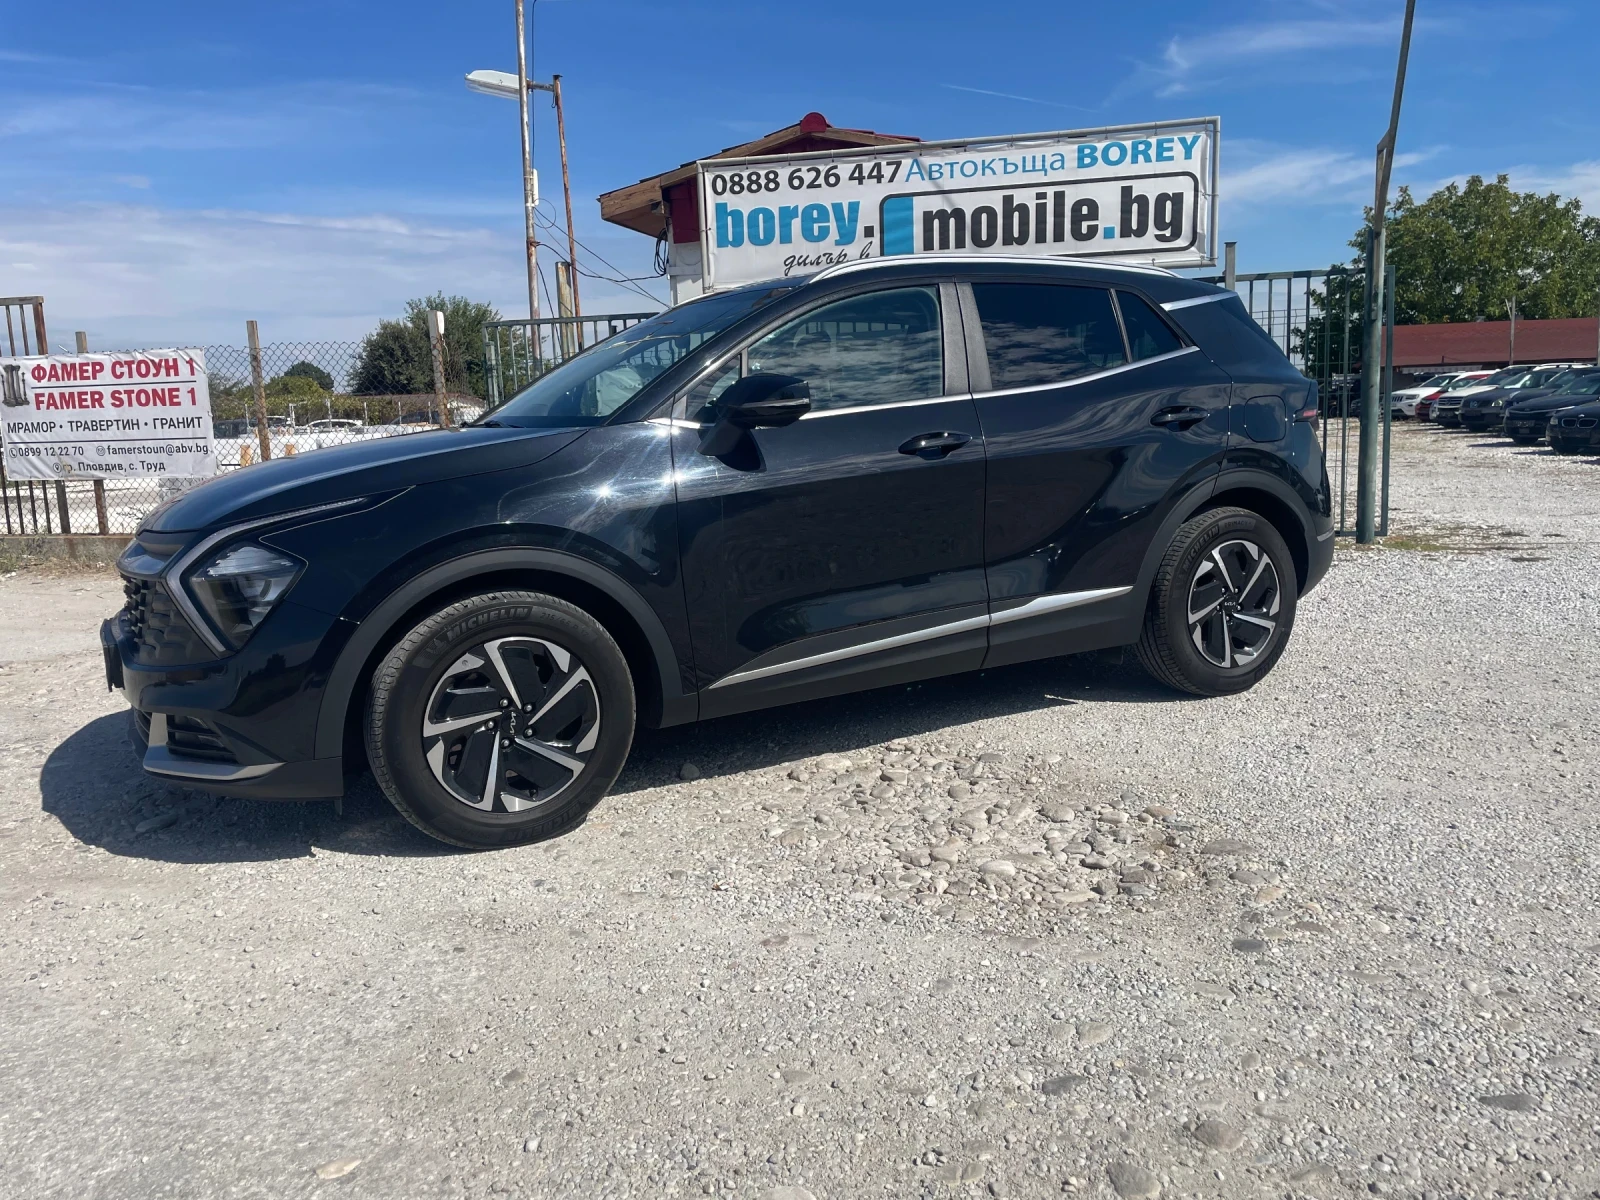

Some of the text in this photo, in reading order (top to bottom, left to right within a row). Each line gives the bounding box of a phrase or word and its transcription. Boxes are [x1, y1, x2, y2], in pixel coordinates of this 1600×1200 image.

[904, 134, 1202, 183] Автокъща BOREY
[711, 160, 903, 196] 0888 626 447
[922, 185, 1185, 251] mobile.bg
[31, 358, 197, 383] ФАМЕР СТОУН 1
[34, 387, 197, 411] FAMER STONE 1
[7, 416, 203, 434] МРАМОР ТРАВЕРТИН ГРАНИТ
[18, 442, 209, 457] 0899 12 22 70 famerstoun@abv.bg
[77, 461, 128, 473] Пловдив,
[139, 460, 166, 472] Труд
[1181, 525, 1220, 572] MICHELIN
[446, 607, 529, 642] MICHELIN
